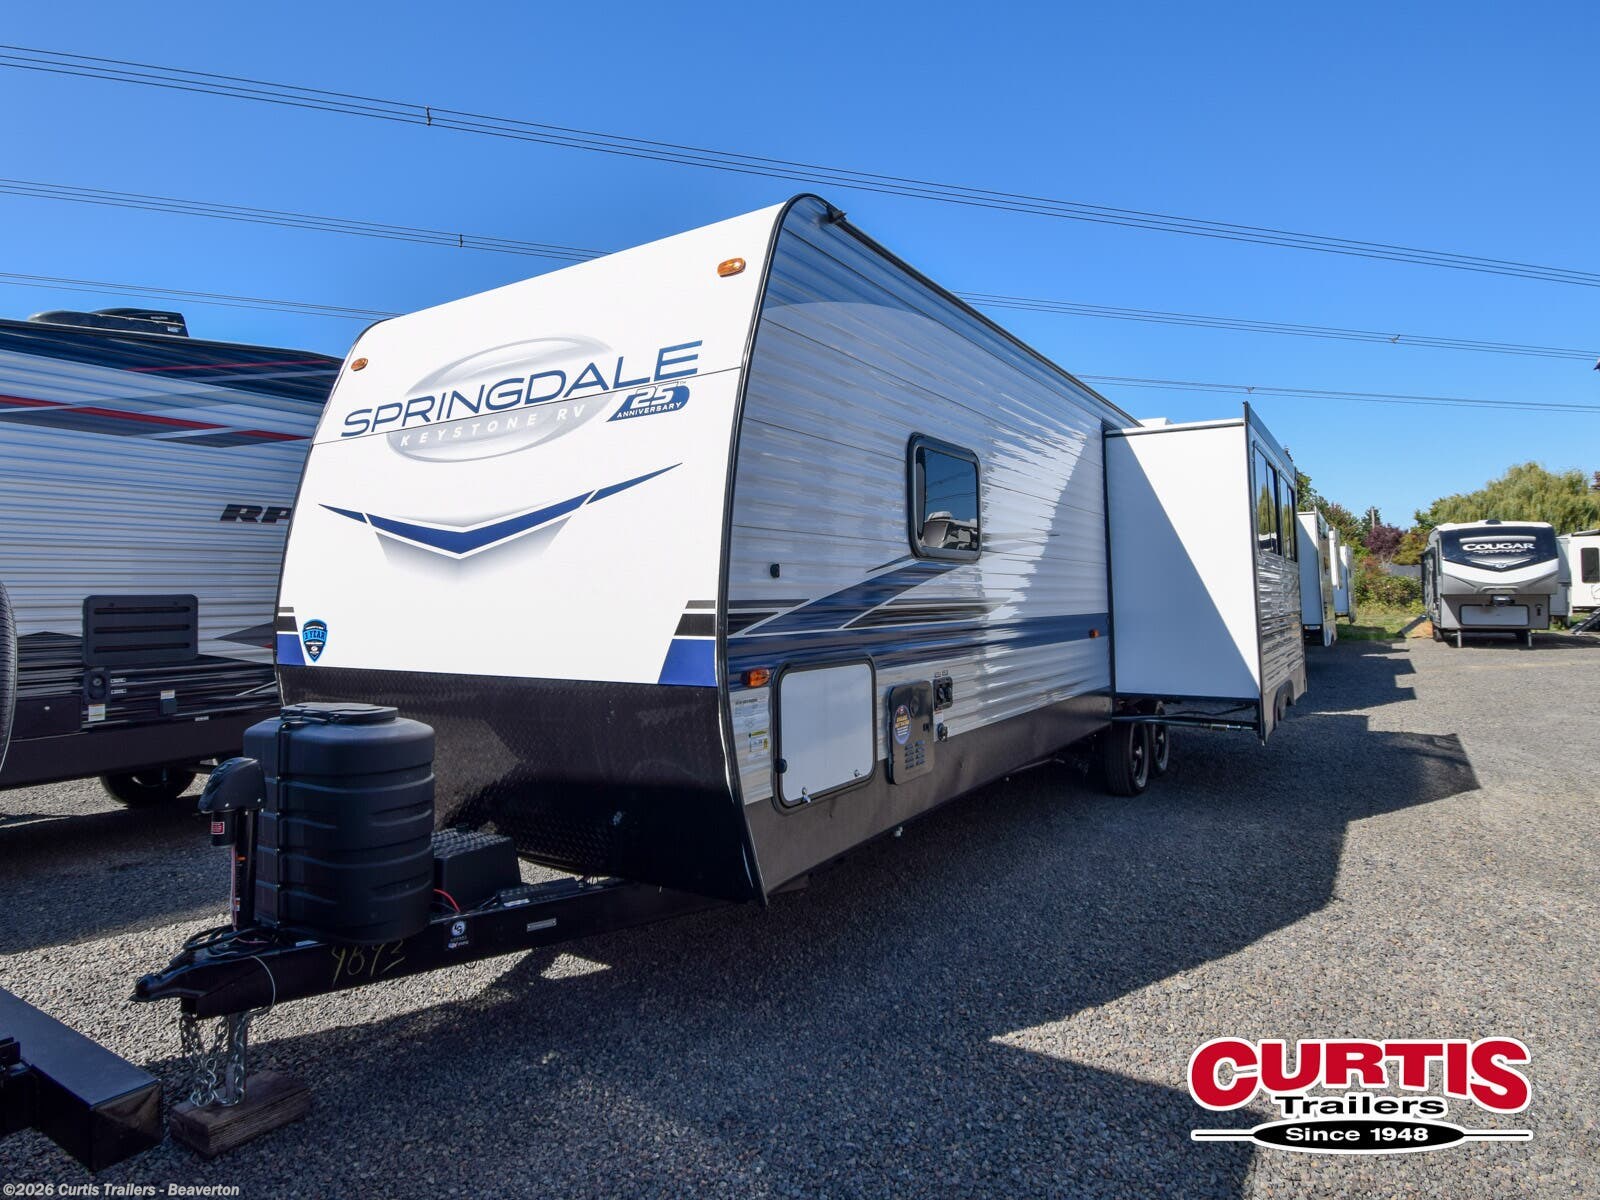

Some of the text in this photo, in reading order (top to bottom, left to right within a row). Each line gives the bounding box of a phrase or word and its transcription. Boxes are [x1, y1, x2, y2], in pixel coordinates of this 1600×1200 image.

[340, 340, 703, 437] SPRINGDALE
[630, 382, 679, 409] 25
[616, 401, 682, 418] ANNIVERSARY
[400, 404, 587, 447] KEYSTONE RV
[1462, 542, 1536, 551] COUGAR
